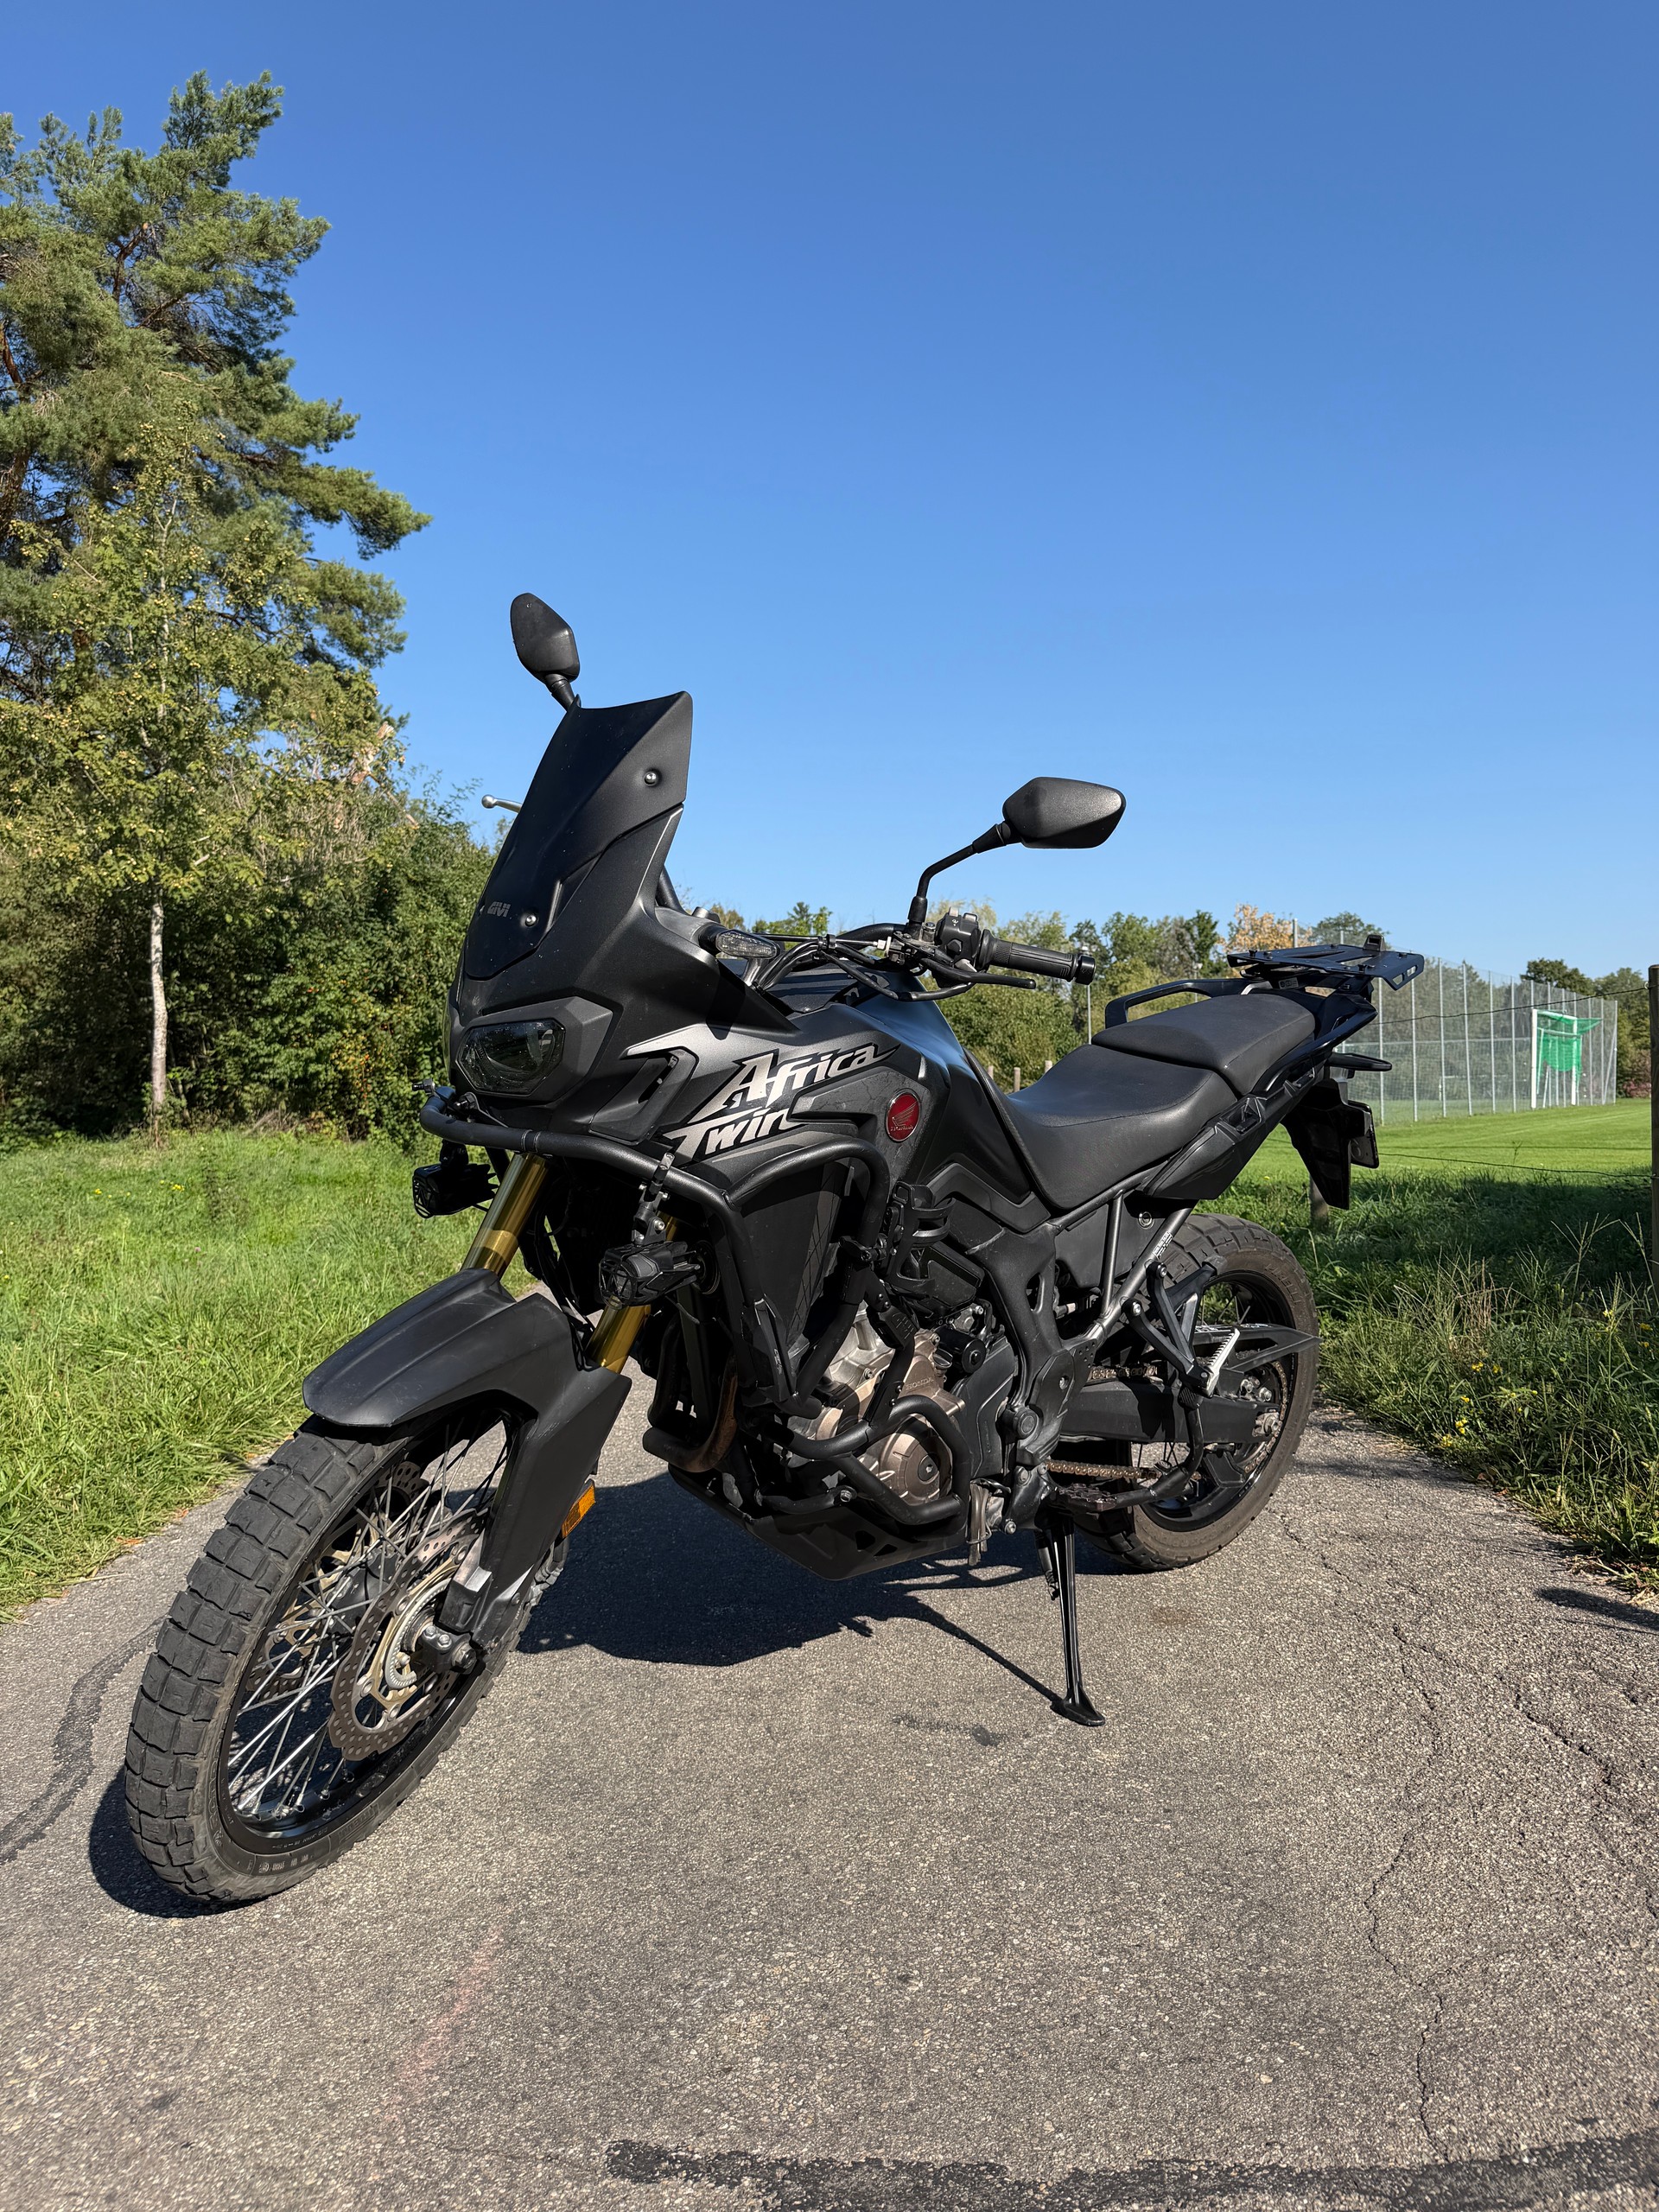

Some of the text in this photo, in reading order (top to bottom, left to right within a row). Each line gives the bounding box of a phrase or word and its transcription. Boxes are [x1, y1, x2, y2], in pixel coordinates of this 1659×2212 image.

[487, 901, 512, 918] GIVI
[689, 1043, 899, 1123] Africa
[663, 1104, 800, 1161] Twin
[1264, 1263, 1302, 1306] PIRELLI
[905, 1376, 934, 1390] HONDA
